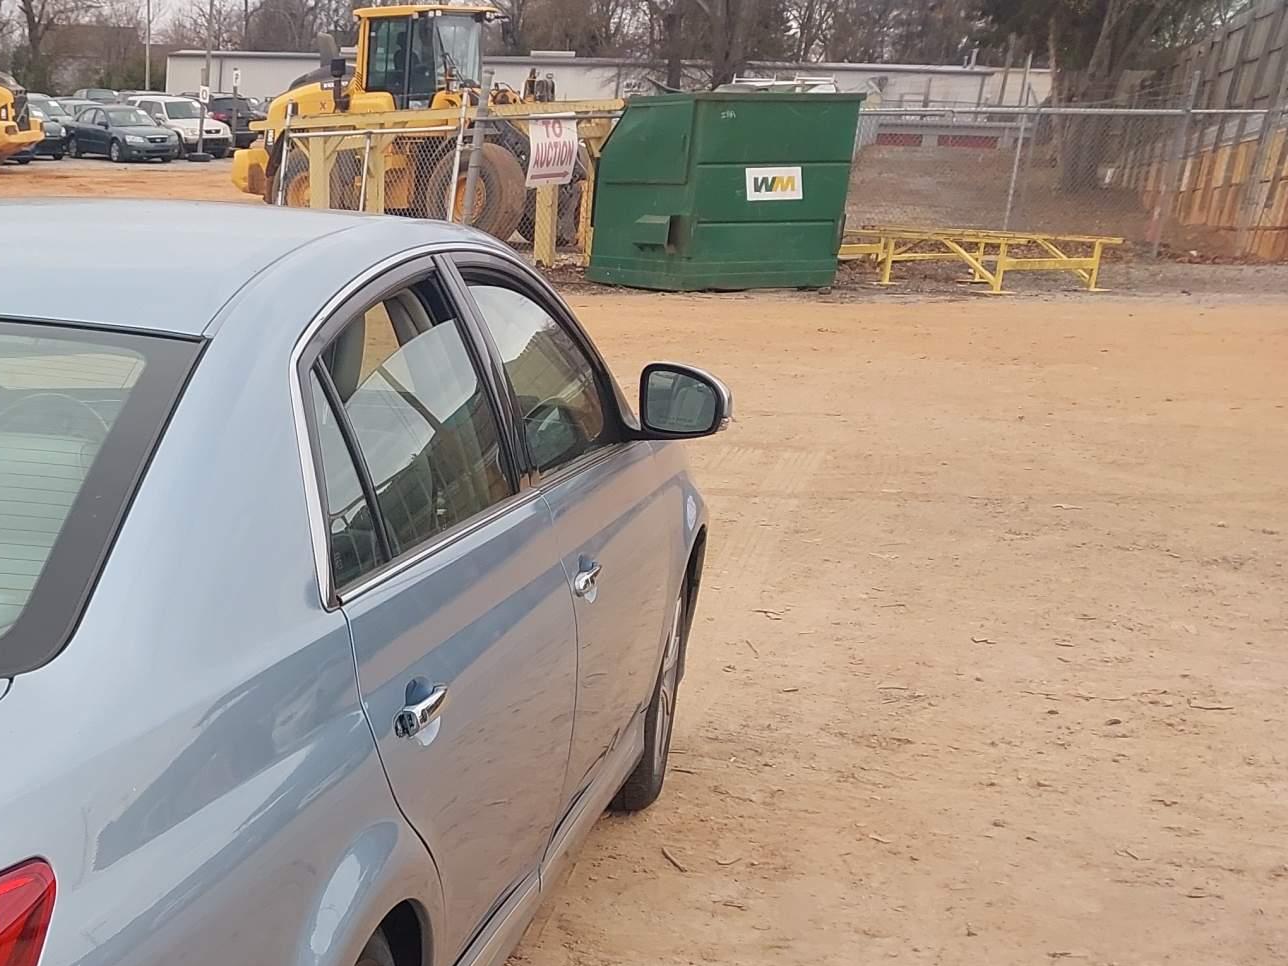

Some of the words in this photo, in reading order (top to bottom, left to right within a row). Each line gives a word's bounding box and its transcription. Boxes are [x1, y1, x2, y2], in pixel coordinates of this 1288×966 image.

[541, 119, 563, 139] TO
[533, 141, 575, 169] AUCTION
[753, 176, 796, 193] WM
